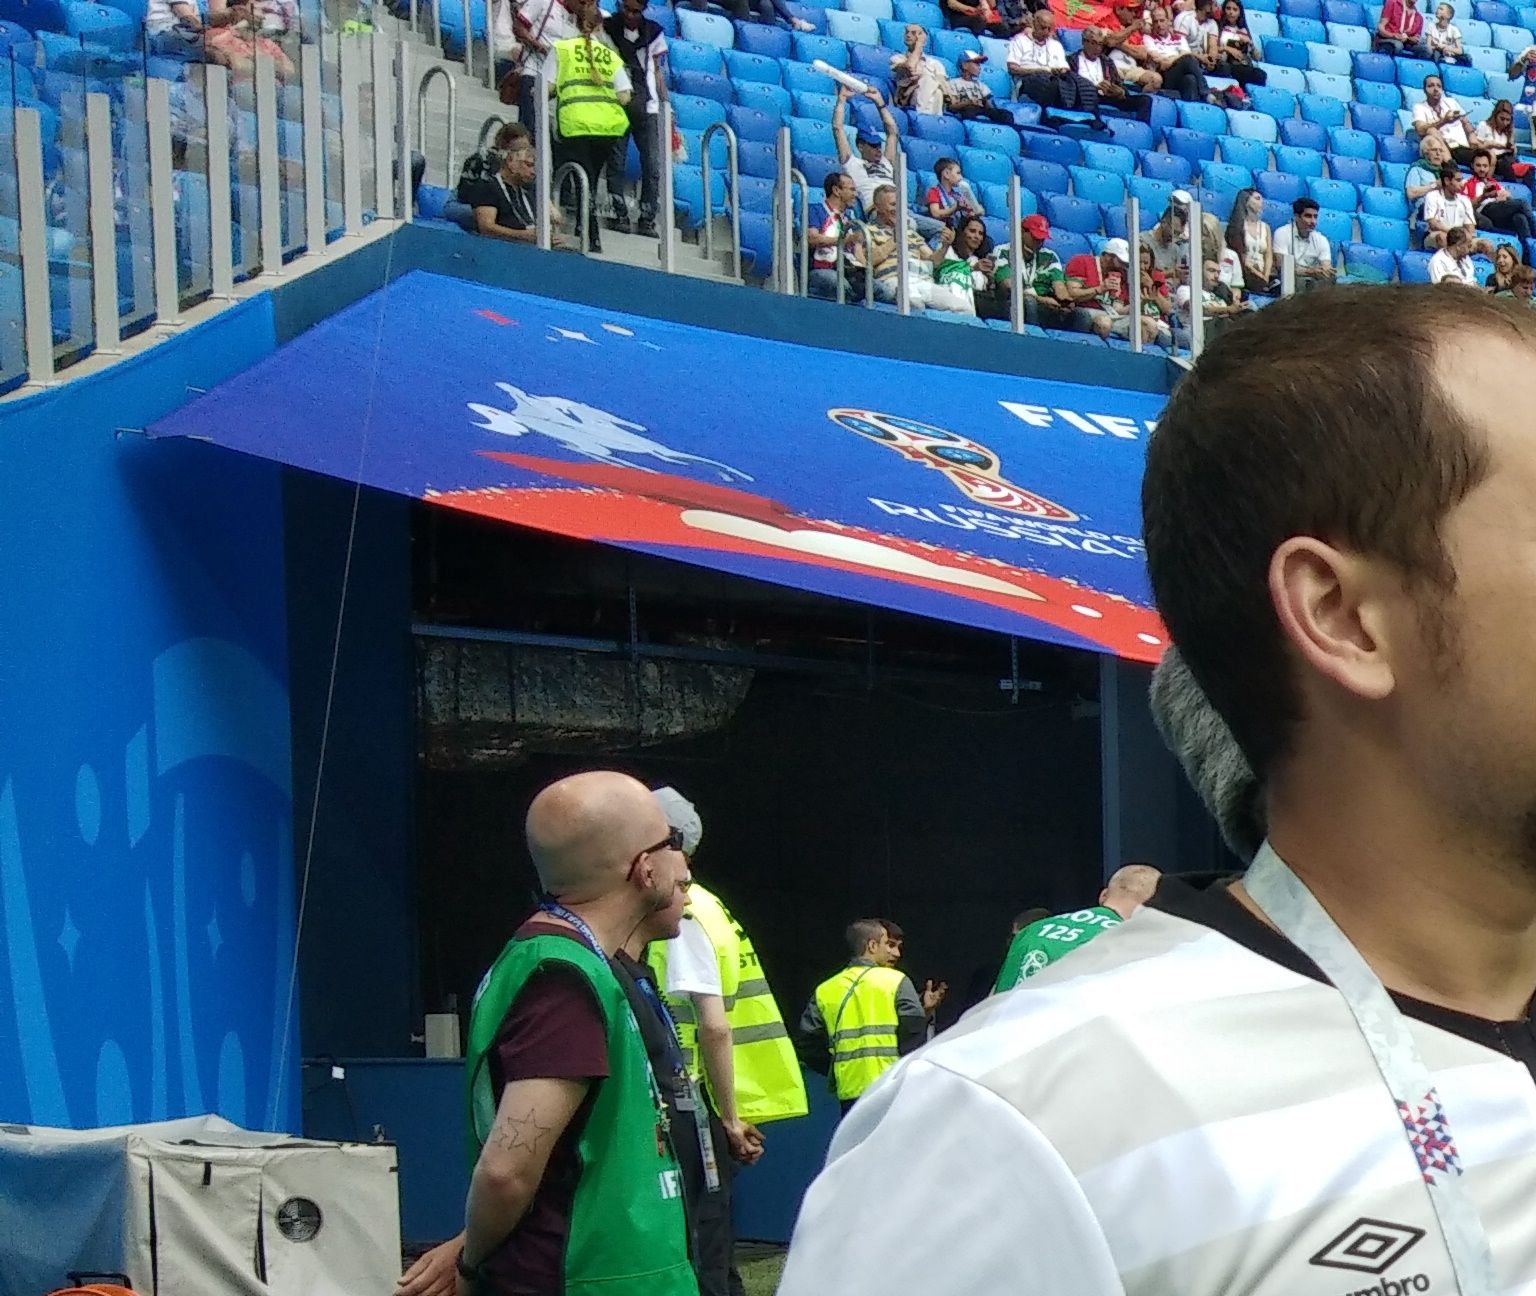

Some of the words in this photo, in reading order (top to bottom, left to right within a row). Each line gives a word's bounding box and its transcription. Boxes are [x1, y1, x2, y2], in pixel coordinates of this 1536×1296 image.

[998, 400, 1158, 440] FIF
[867, 496, 1135, 559] RUSSIA
[1037, 923, 1084, 942] 125
